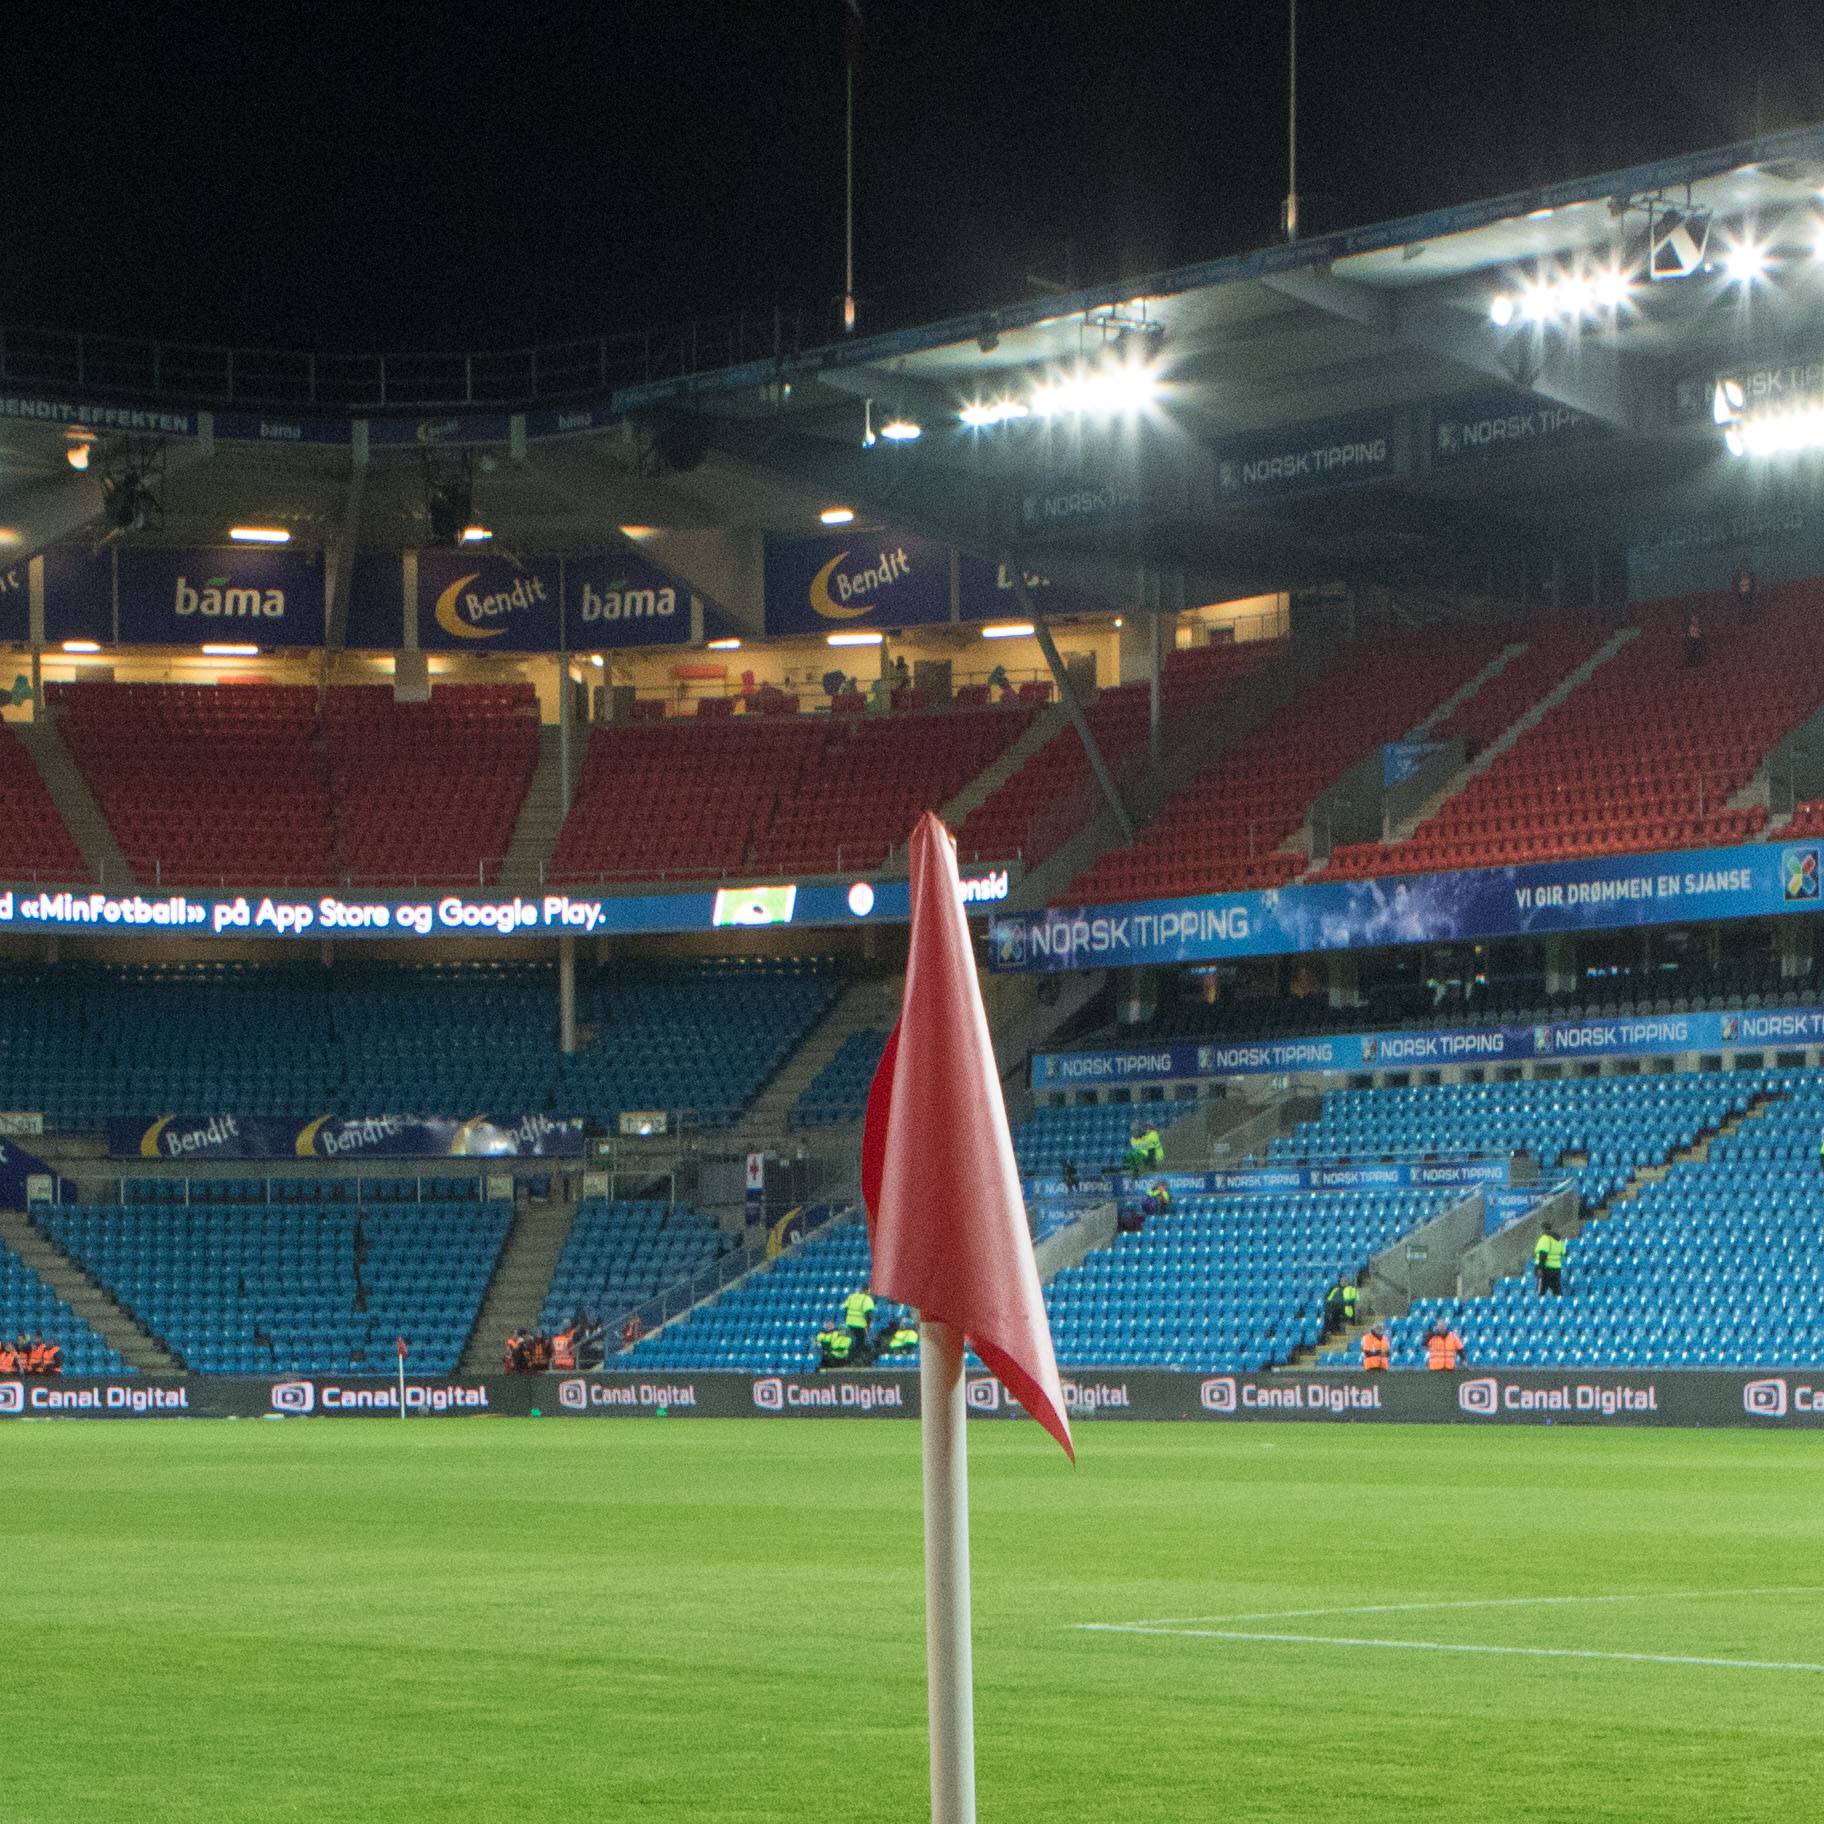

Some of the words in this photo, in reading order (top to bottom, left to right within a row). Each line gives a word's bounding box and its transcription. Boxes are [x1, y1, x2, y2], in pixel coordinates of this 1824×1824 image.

[1463, 414, 1537, 447] NORSK
[1243, 452, 1308, 485] NORSK
[1313, 439, 1387, 473] TIPPING
[836, 547, 912, 602] Bendit
[175, 577, 285, 619] bama
[465, 573, 549, 623] Bendit
[581, 580, 676, 621] bama
[1515, 888, 1532, 909] VI
[1535, 886, 1565, 907] GIR
[1567, 877, 1653, 904] DRØMMEN
[1657, 876, 1681, 897] EN
[1684, 868, 1752, 895] SJANSE
[212, 897, 251, 933] på
[255, 897, 314, 933] App
[319, 897, 390, 927] Store
[395, 905, 433, 934] og
[438, 897, 538, 934] Google
[543, 896, 607, 931] Play.
[1032, 918, 1130, 956] NORSK
[1135, 907, 1249, 947] TIPPING
[1555, 1029, 1616, 1047] NORSK
[1619, 1023, 1688, 1043] TIPPING
[1741, 1017, 1807, 1037] NORSK
[1216, 1048, 1268, 1066] NORSK
[1273, 1044, 1333, 1064] TIPPING
[1380, 1040, 1437, 1059] NORSK
[1440, 1034, 1504, 1053] TIPPING
[1062, 1060, 1111, 1076] NORSK
[1115, 1054, 1172, 1073] TIPPING
[164, 1113, 240, 1156] Bendit
[30, 1385, 104, 1410] Canal
[106, 1384, 189, 1412] Digital
[321, 1385, 400, 1409] Canal
[405, 1383, 489, 1411] Digital
[590, 1383, 637, 1405] Canal
[640, 1383, 696, 1408] Digital
[786, 1383, 839, 1406] Canal
[841, 1383, 903, 1409] Digital
[1062, 1384, 1130, 1410] Digital
[1242, 1385, 1301, 1409] Canal
[1307, 1384, 1381, 1411] Digital
[1504, 1384, 1571, 1411] Canal
[1576, 1384, 1658, 1415] Digital
